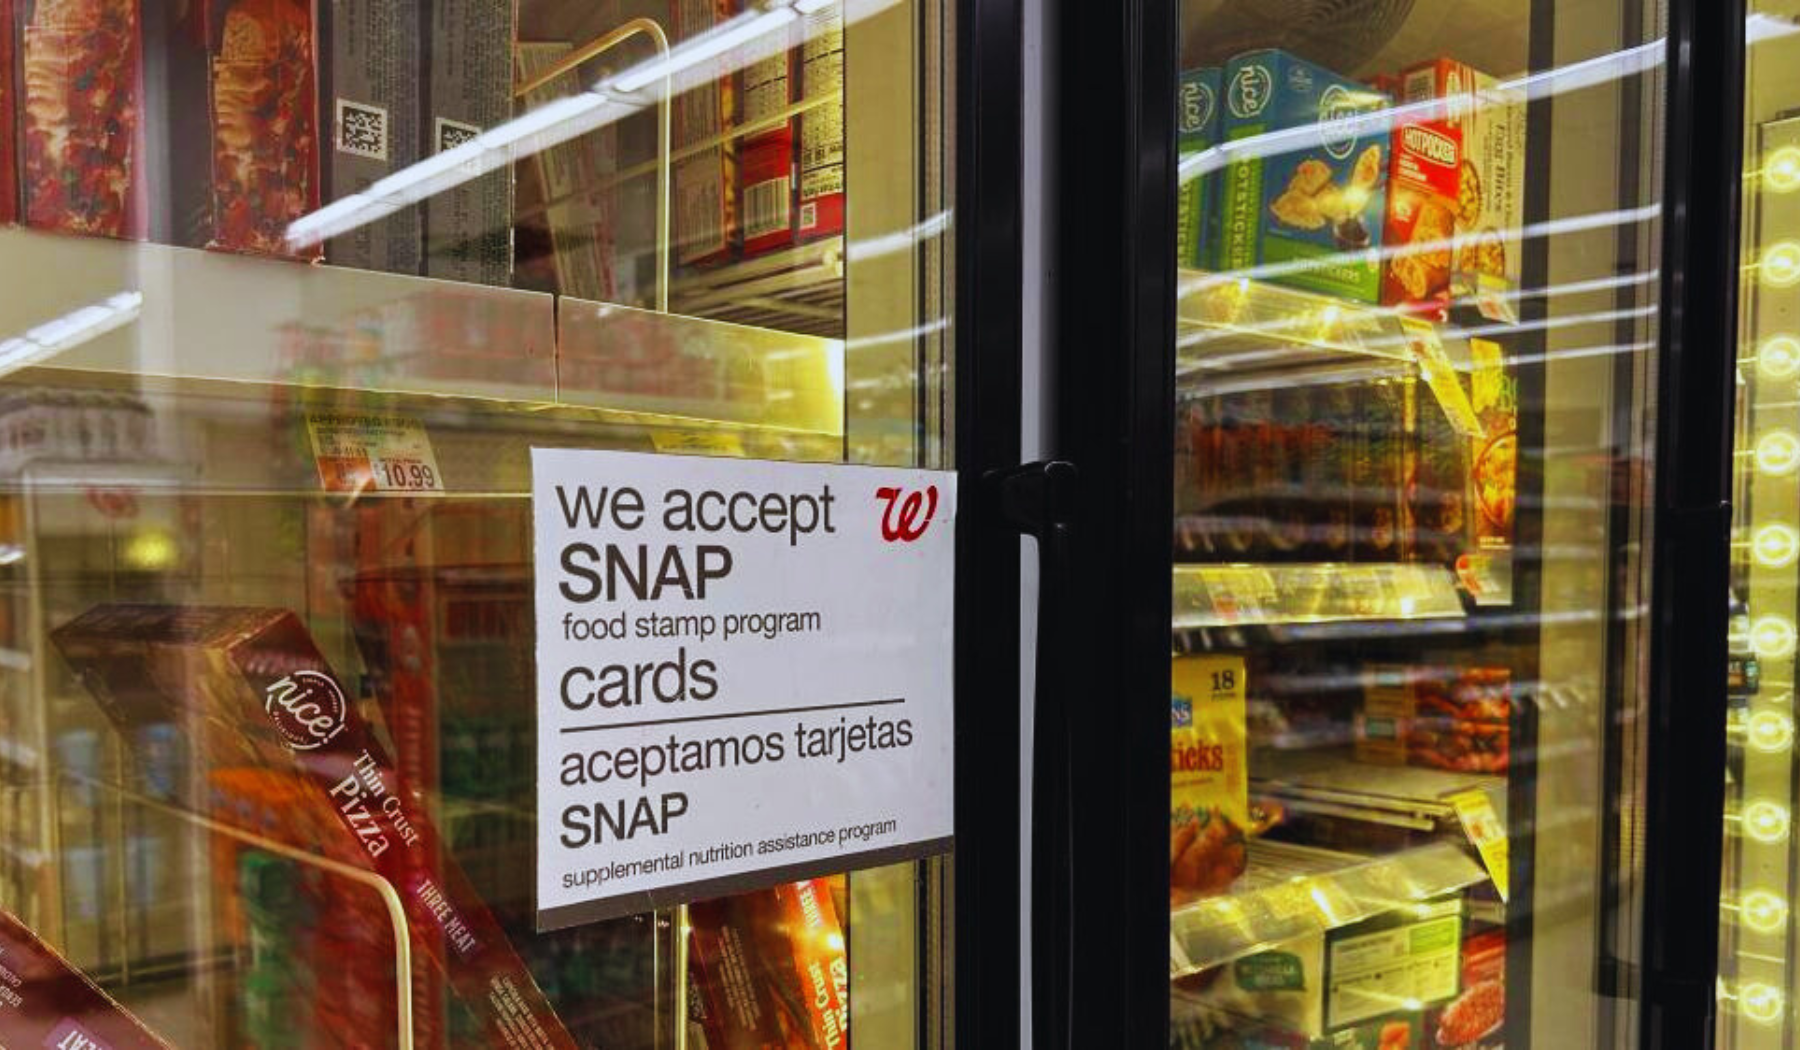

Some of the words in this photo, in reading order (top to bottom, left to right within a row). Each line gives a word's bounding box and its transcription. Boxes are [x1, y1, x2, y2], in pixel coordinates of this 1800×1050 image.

[556, 485, 645, 530] we
[663, 485, 835, 545] accept
[559, 542, 733, 603] SNAP
[563, 611, 626, 640] food
[635, 612, 716, 641] stamp
[724, 611, 821, 642] program
[560, 647, 718, 710] cards
[1211, 669, 1235, 690] 18
[560, 733, 784, 787] aceptamos
[794, 716, 912, 763] tarjetas
[329, 774, 389, 858] Pizza
[353, 749, 386, 797] Thin
[383, 796, 419, 847] Crust
[560, 792, 688, 848] SNAP
[562, 852, 685, 888] supplemental
[689, 841, 753, 867] nutrition
[758, 829, 836, 855] assistance
[838, 818, 897, 848] program
[416, 879, 453, 922] THREE
[445, 916, 476, 953] MEAT
[56, 1029, 106, 1050] EAT
